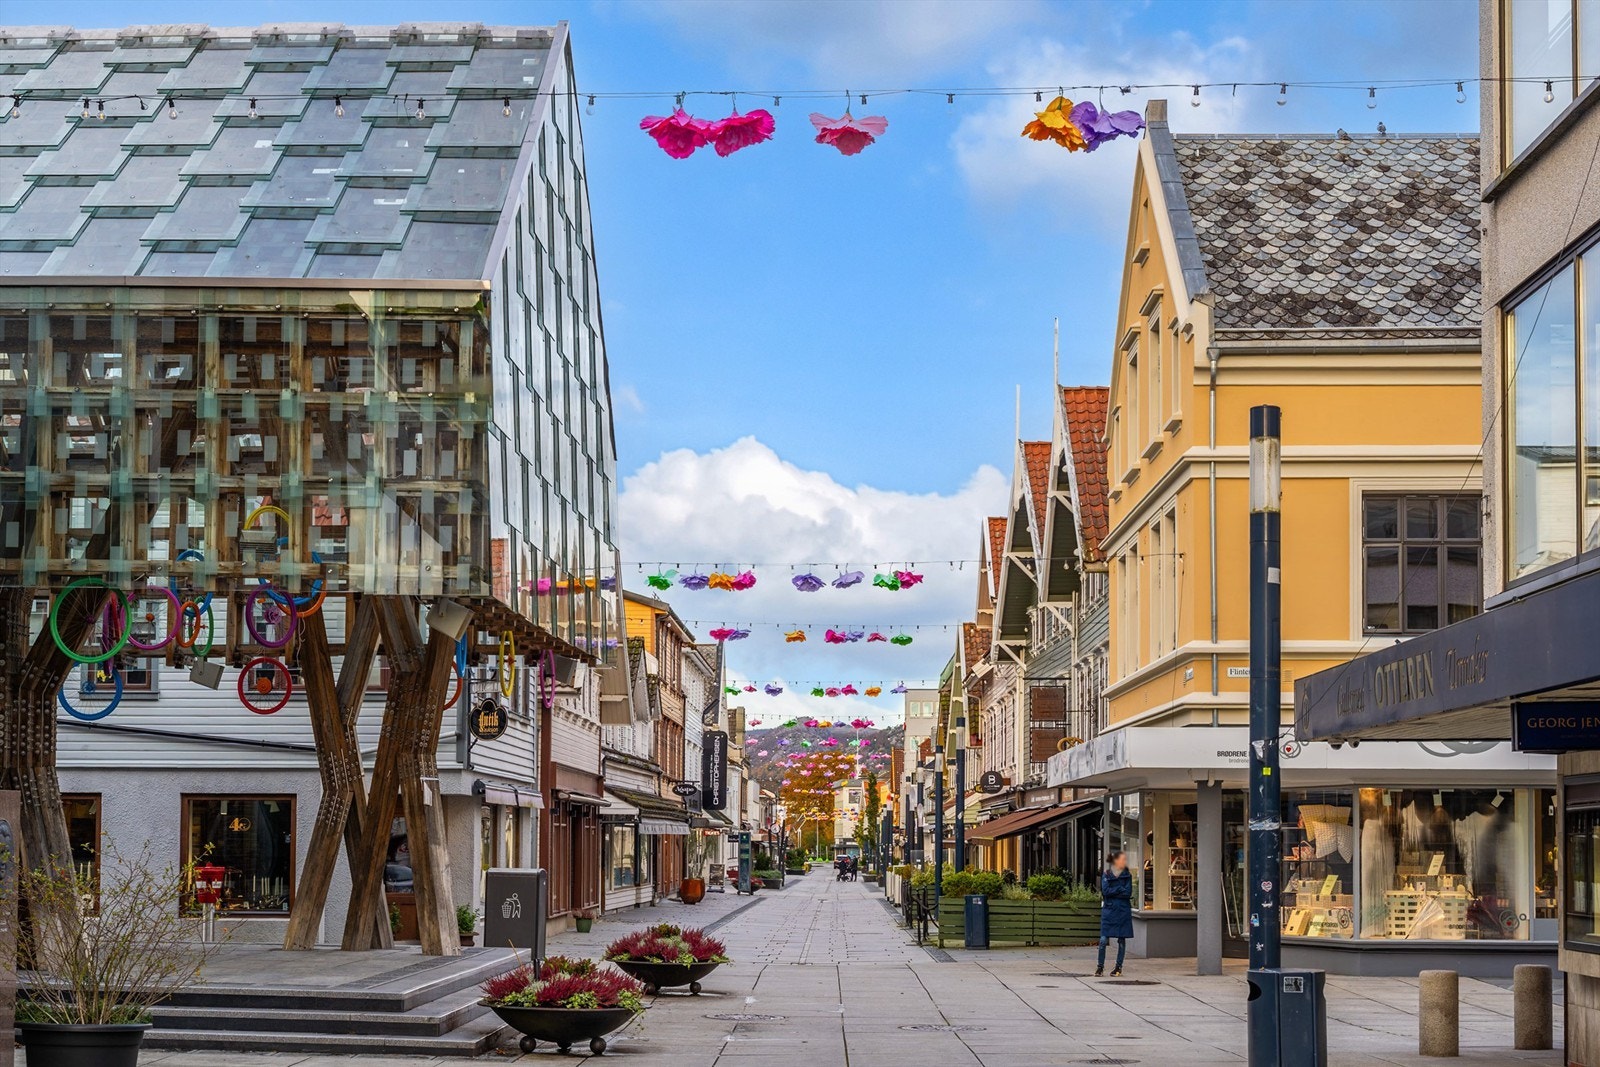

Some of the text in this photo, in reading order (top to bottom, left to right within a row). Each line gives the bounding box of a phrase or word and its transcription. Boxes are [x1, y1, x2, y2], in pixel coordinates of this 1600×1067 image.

[1374, 651, 1434, 708] OTTEREN
[1527, 717, 1577, 728] GEORG
[988, 775, 996, 785] B
